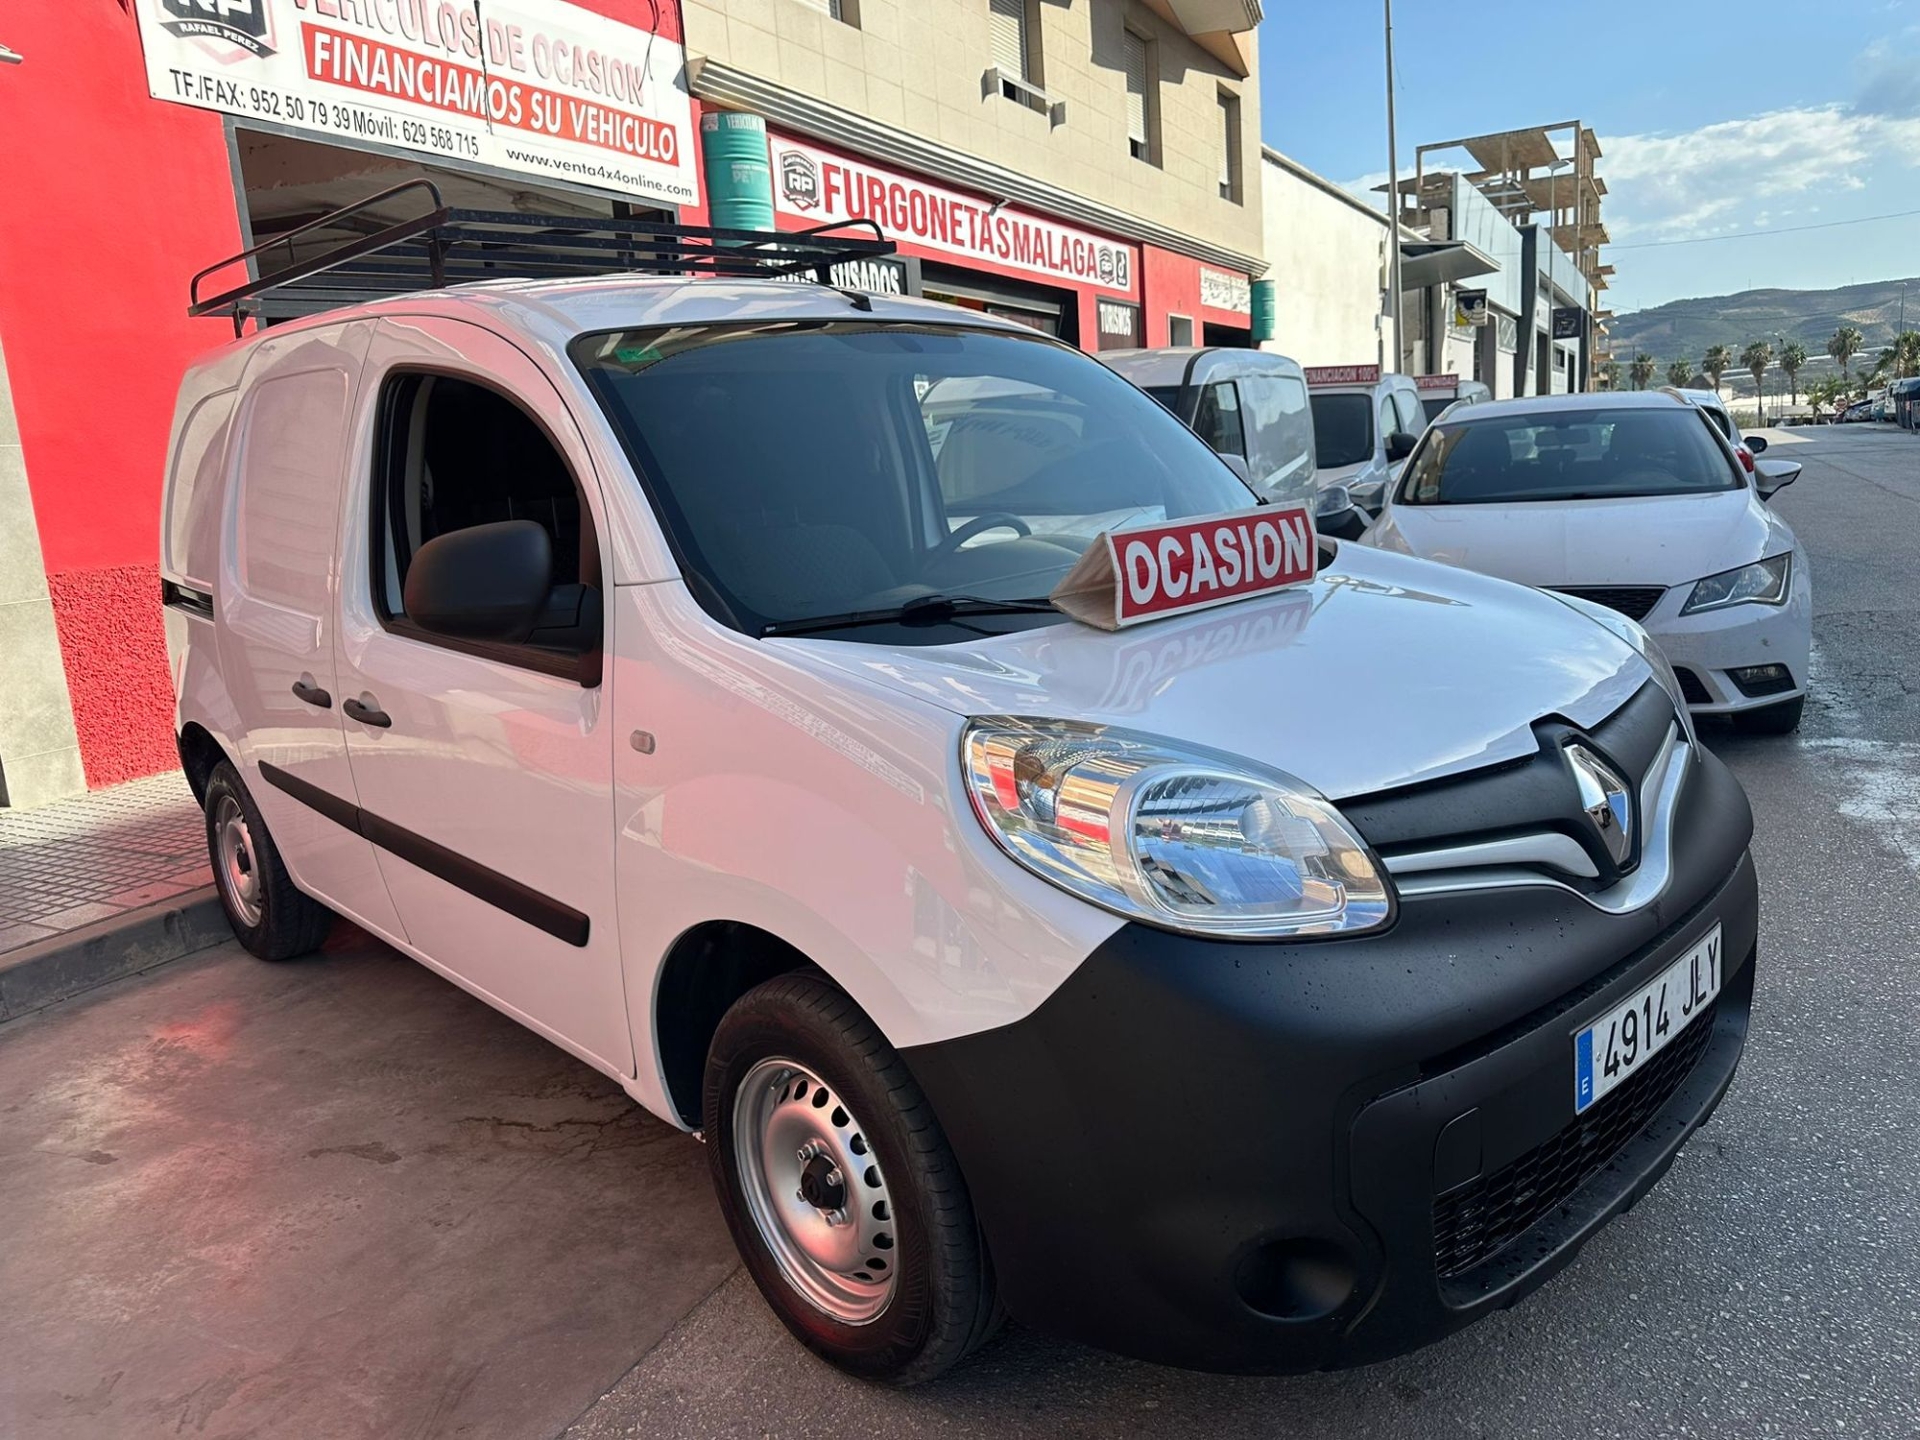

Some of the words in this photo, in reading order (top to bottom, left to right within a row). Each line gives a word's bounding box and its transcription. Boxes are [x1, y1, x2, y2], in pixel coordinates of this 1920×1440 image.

[179, 23, 222, 36] RAFAEL
[223, 29, 259, 52] PEREZ
[487, 18, 526, 73] DE
[532, 33, 643, 107] OCASION
[169, 69, 246, 109] TF./FAX:
[250, 87, 281, 116] 952
[286, 95, 304, 121] 50
[308, 100, 327, 126] 79
[332, 105, 350, 131] 39
[353, 111, 398, 140] Móvil:
[403, 120, 426, 145] 629
[431, 126, 453, 150] 568
[456, 132, 479, 156] 715
[314, 31, 522, 125] FINANCIAMOS
[530, 92, 562, 134] SU
[569, 101, 675, 161] VEHICULO
[506, 149, 692, 197] www.venta4x4online.com
[789, 172, 813, 192] RP
[822, 162, 1098, 279] FURGONETASMALAGA
[1125, 516, 1308, 605] OCASION
[1580, 1077, 1590, 1096] E
[1604, 982, 1670, 1078] 4914
[1682, 936, 1718, 1016] JLY
